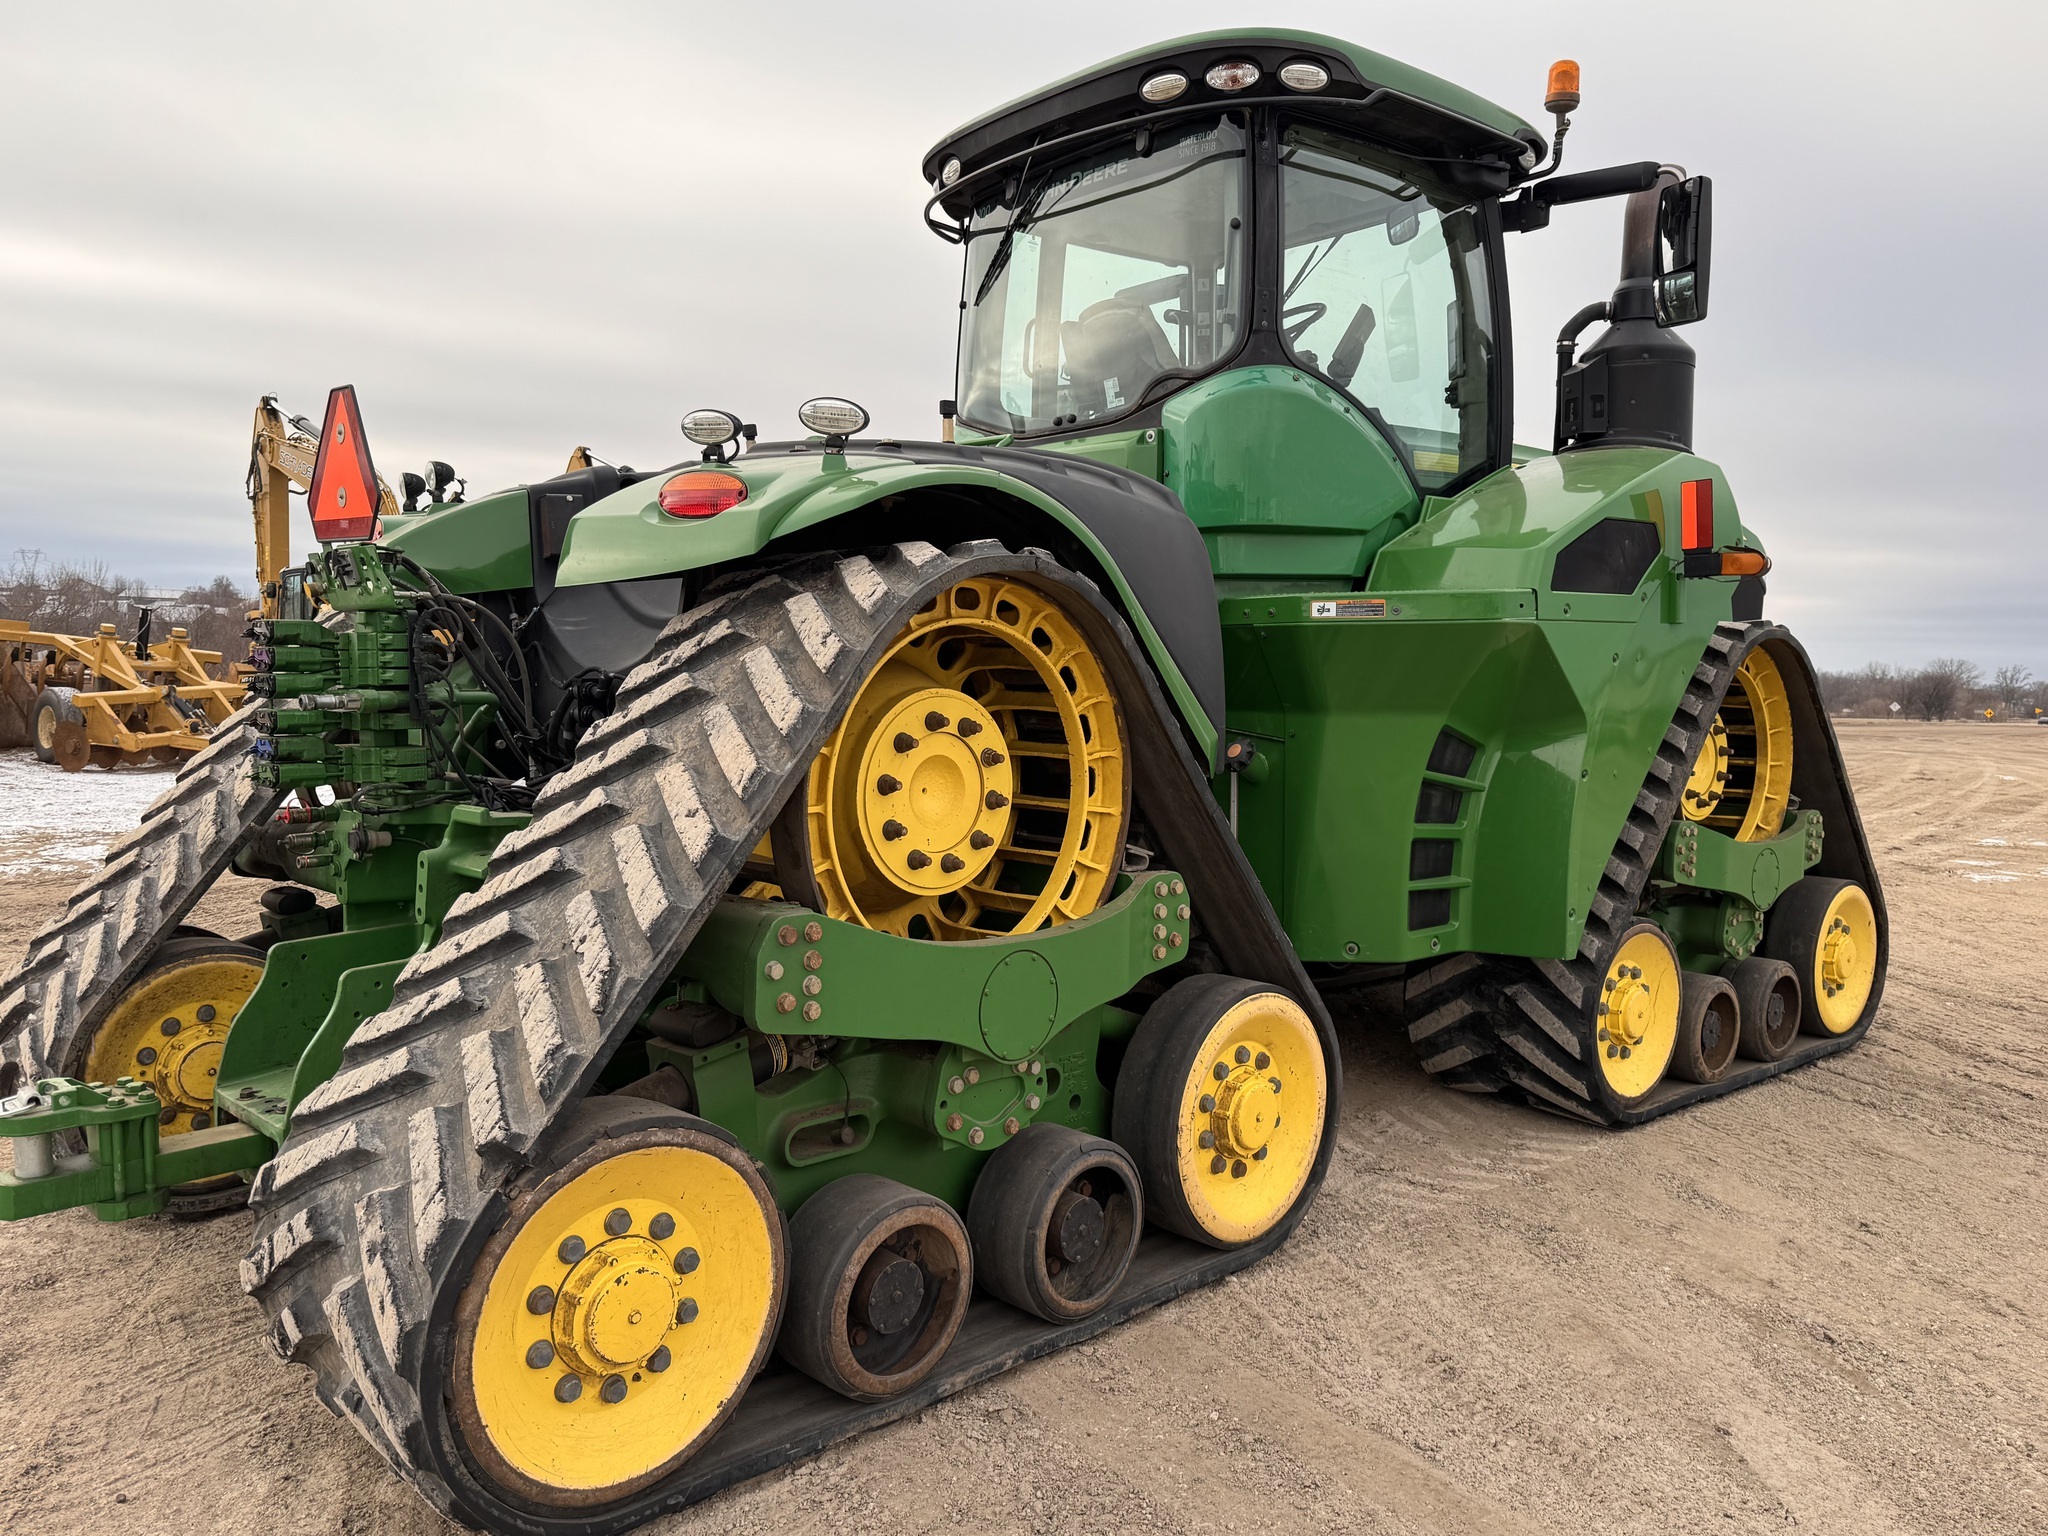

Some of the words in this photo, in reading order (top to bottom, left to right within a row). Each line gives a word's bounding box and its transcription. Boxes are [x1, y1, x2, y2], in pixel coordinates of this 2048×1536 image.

[1179, 130, 1218, 147] WATERLOO
[1178, 145, 1199, 159] SINCE
[1201, 142, 1216, 153] 1918
[1067, 158, 1129, 191] DEERE
